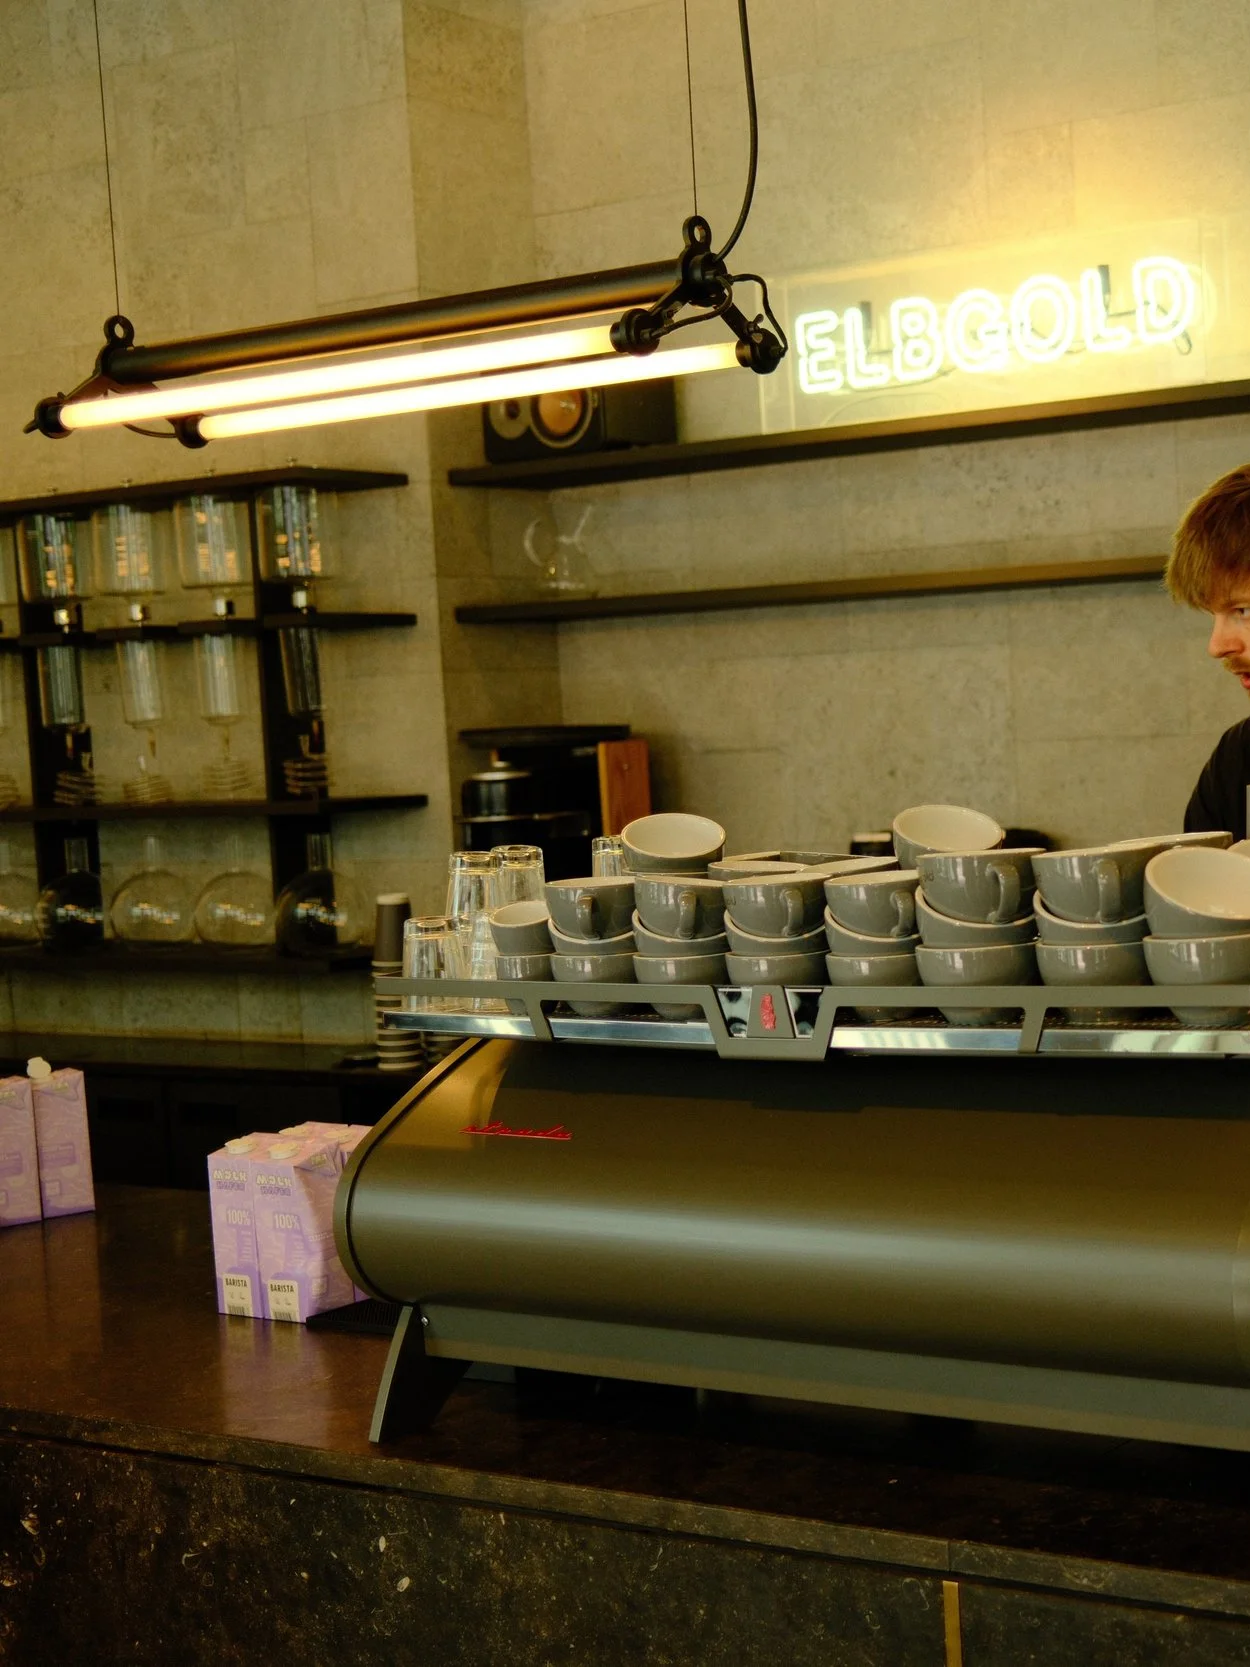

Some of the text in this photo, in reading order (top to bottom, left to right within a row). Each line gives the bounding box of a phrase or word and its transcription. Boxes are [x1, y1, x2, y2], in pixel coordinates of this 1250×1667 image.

[795, 256, 1196, 395] ELBGOLD
[226, 1208, 250, 1226] 100%
[273, 1213, 300, 1229] 100%
[225, 1277, 248, 1288] BARISTA
[270, 1283, 295, 1294] BARISTA
